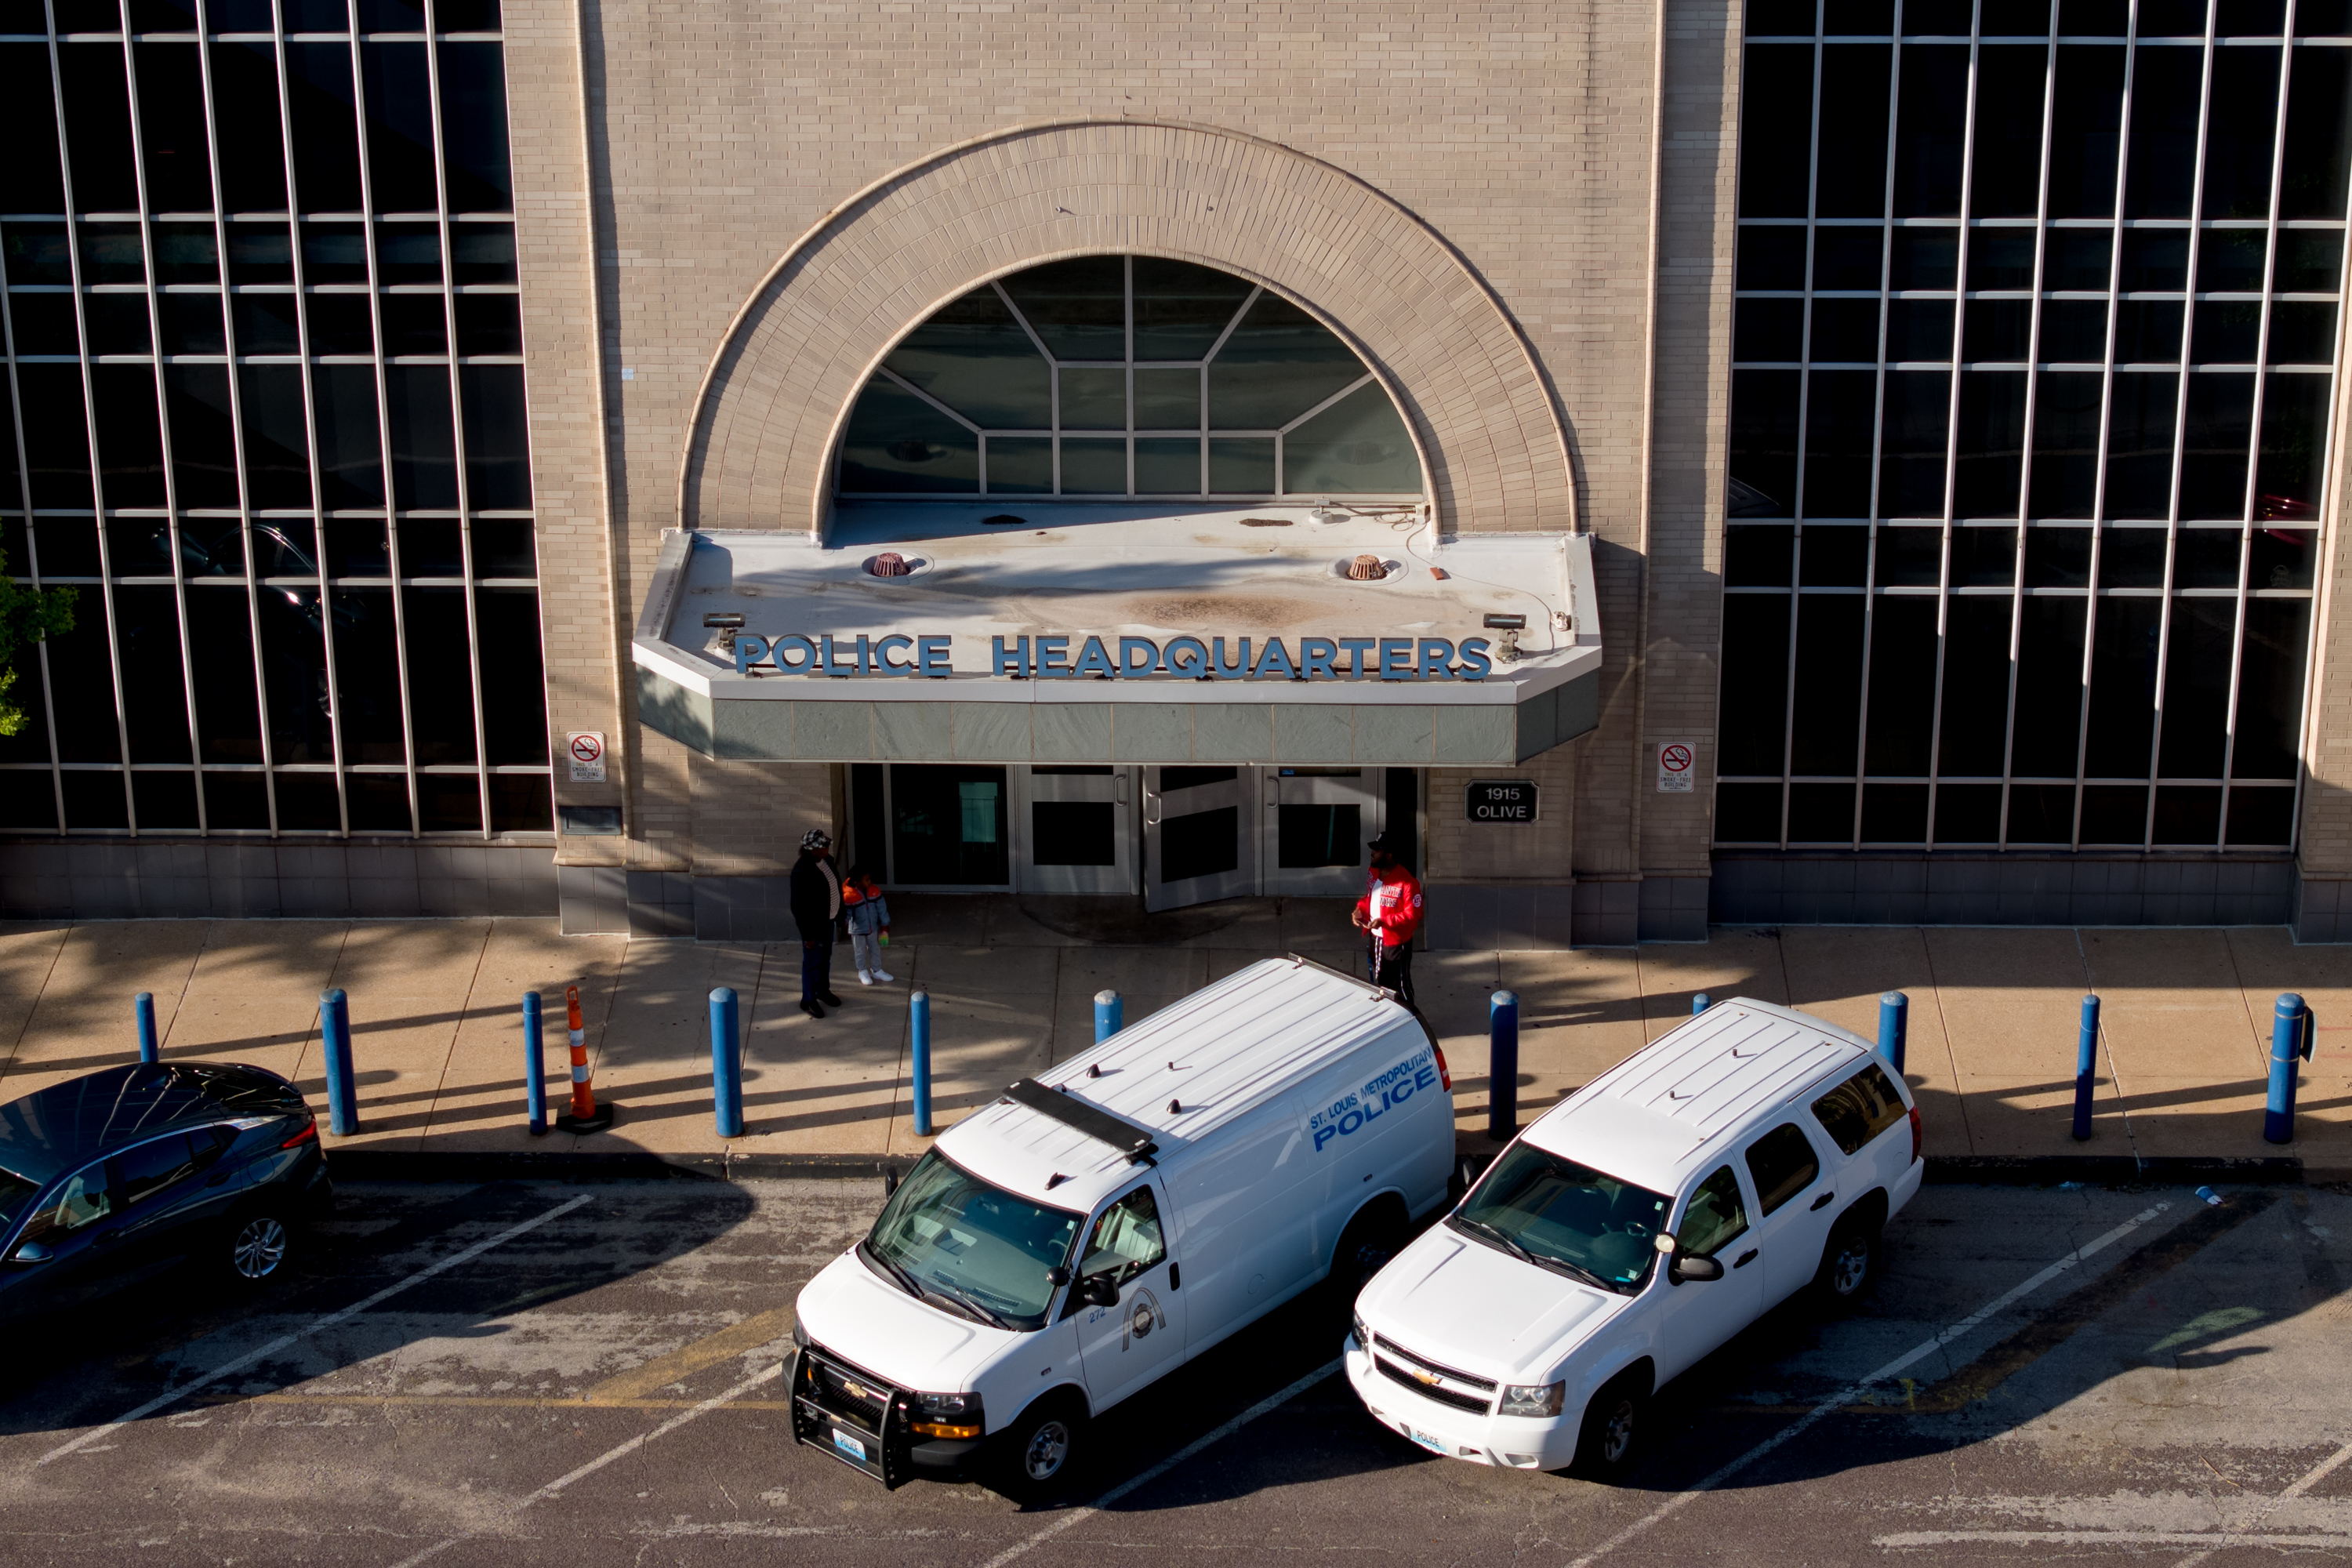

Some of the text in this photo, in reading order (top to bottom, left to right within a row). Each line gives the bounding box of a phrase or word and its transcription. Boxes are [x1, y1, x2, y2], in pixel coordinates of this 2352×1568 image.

[735, 633, 1492, 679] POLICE HEADQUARTERS
[1486, 788, 1520, 800] 1915
[1477, 805, 1526, 818] OLIVE
[1310, 1047, 1432, 1129] ST. LOUIS METROPOLITAN
[1313, 1064, 1436, 1152] POLICE
[1089, 1307, 1106, 1323] 272
[840, 1436, 858, 1454] POLICE
[1417, 1430, 1439, 1447] POLICE
